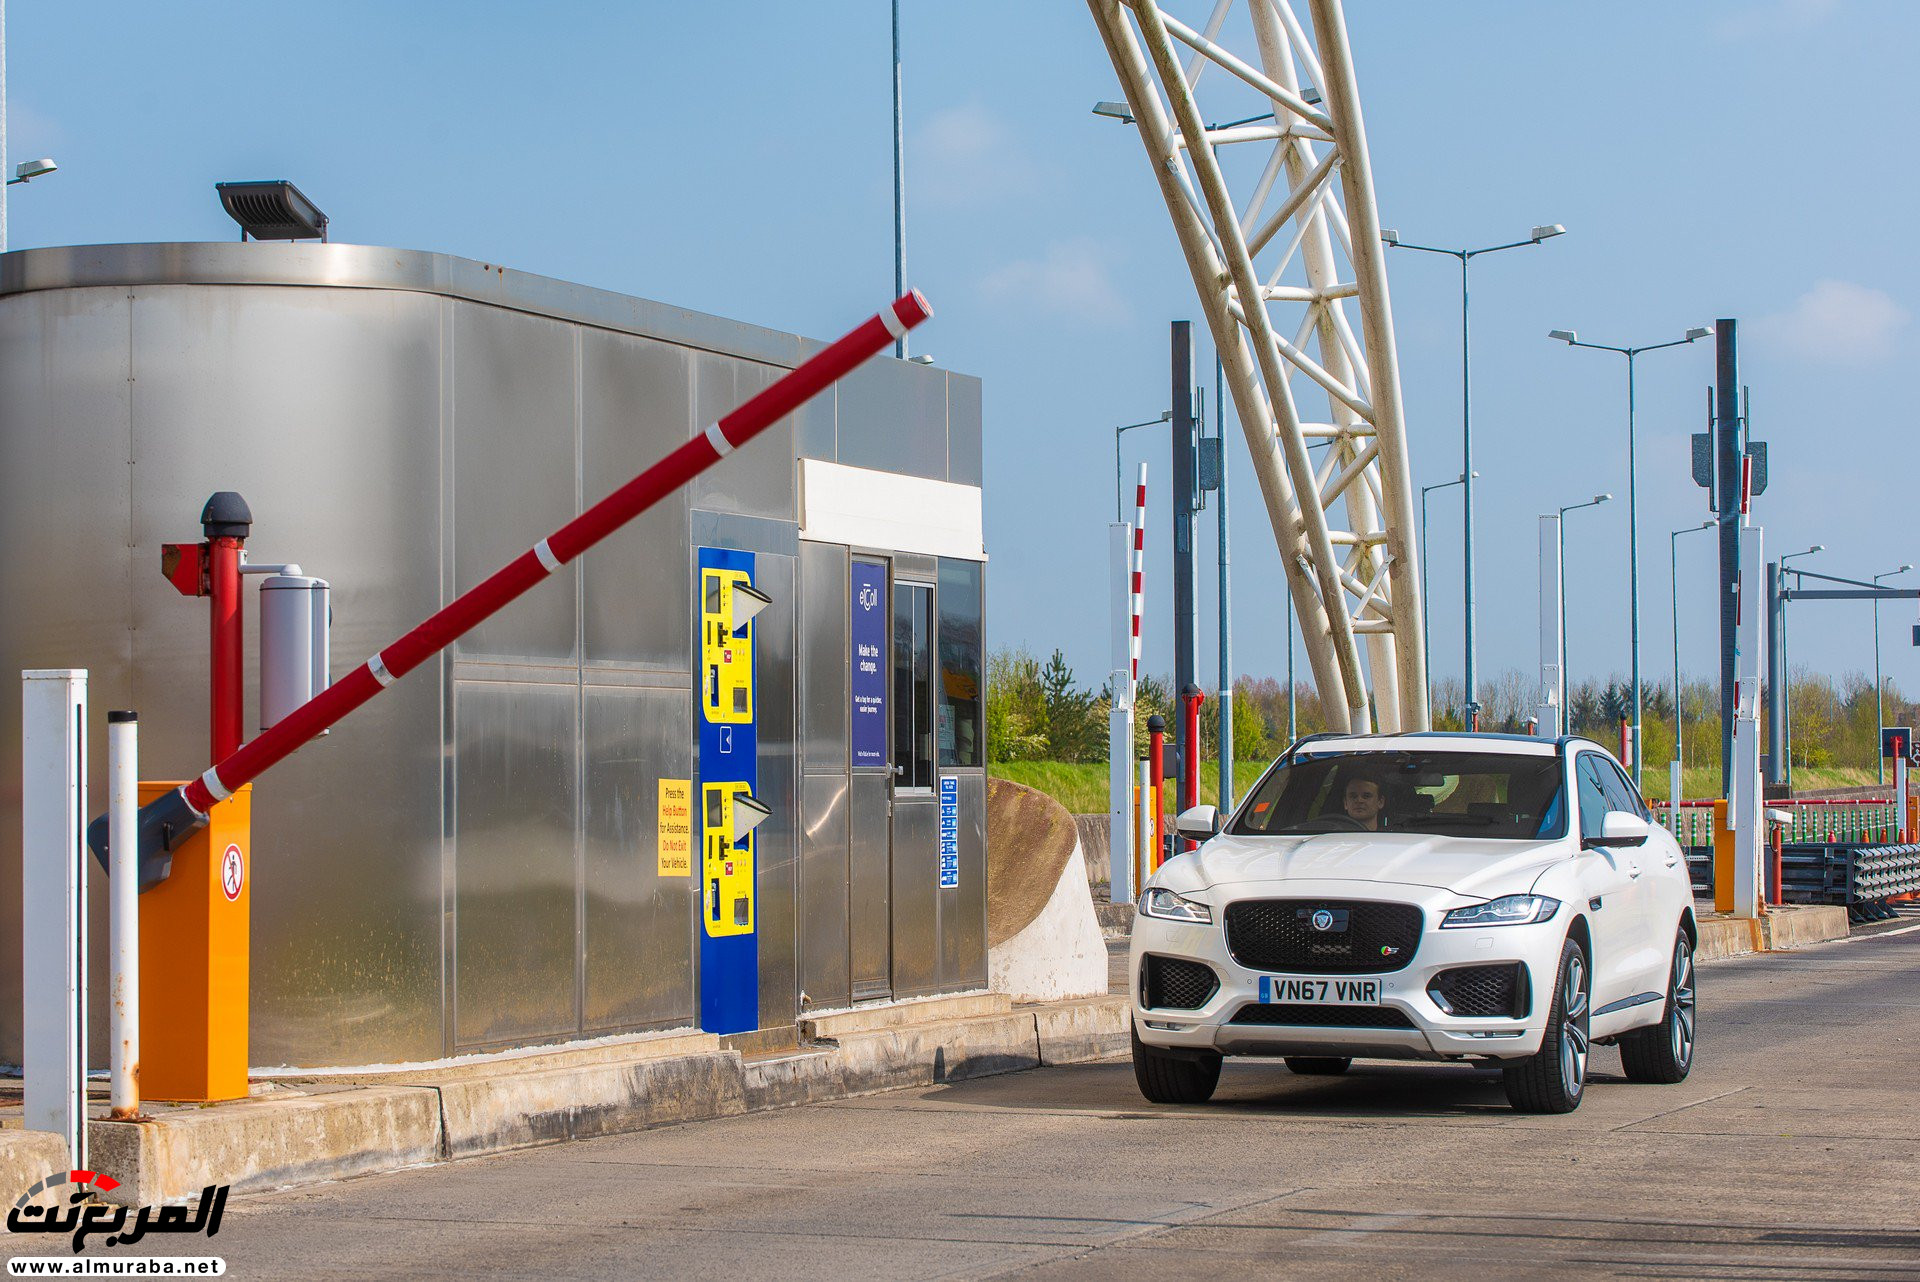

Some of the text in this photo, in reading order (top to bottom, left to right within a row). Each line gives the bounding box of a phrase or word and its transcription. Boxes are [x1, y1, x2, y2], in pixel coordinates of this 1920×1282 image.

[859, 644, 870, 656] Make
[860, 659, 877, 674] change.
[666, 788, 676, 798] Press
[663, 805, 687, 818] Help Button
[667, 822, 689, 834] Assistance.
[663, 840, 669, 851] Do
[678, 840, 686, 851] Exit
[661, 857, 688, 868] Your Vehicle.
[1274, 980, 1376, 1001] VN67 VNR
